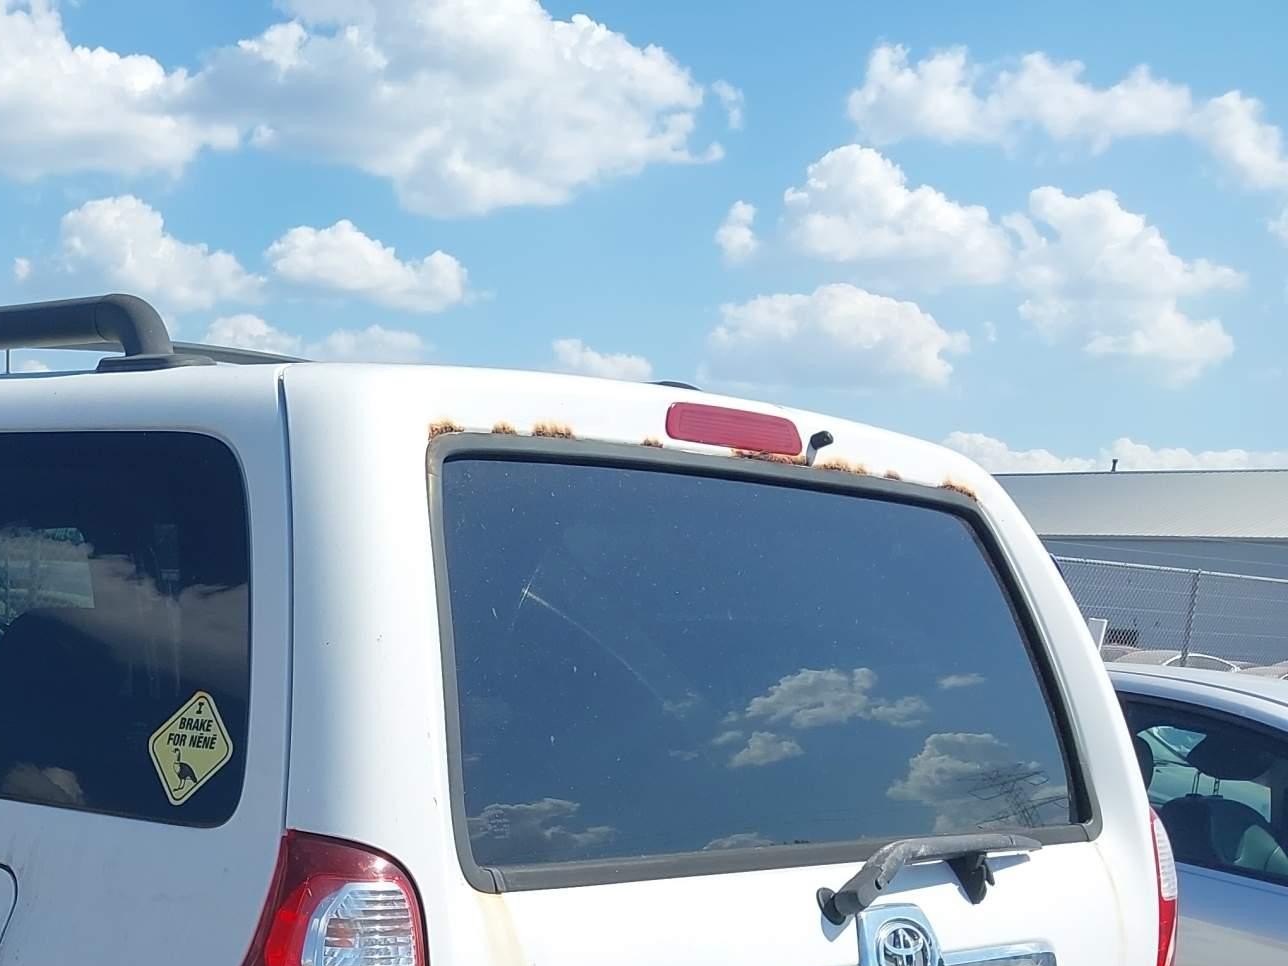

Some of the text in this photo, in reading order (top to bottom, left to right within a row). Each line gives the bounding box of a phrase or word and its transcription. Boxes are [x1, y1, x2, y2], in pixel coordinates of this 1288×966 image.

[196, 701, 205, 715] I
[178, 716, 214, 732] BRAKE
[166, 732, 188, 747] FOR
